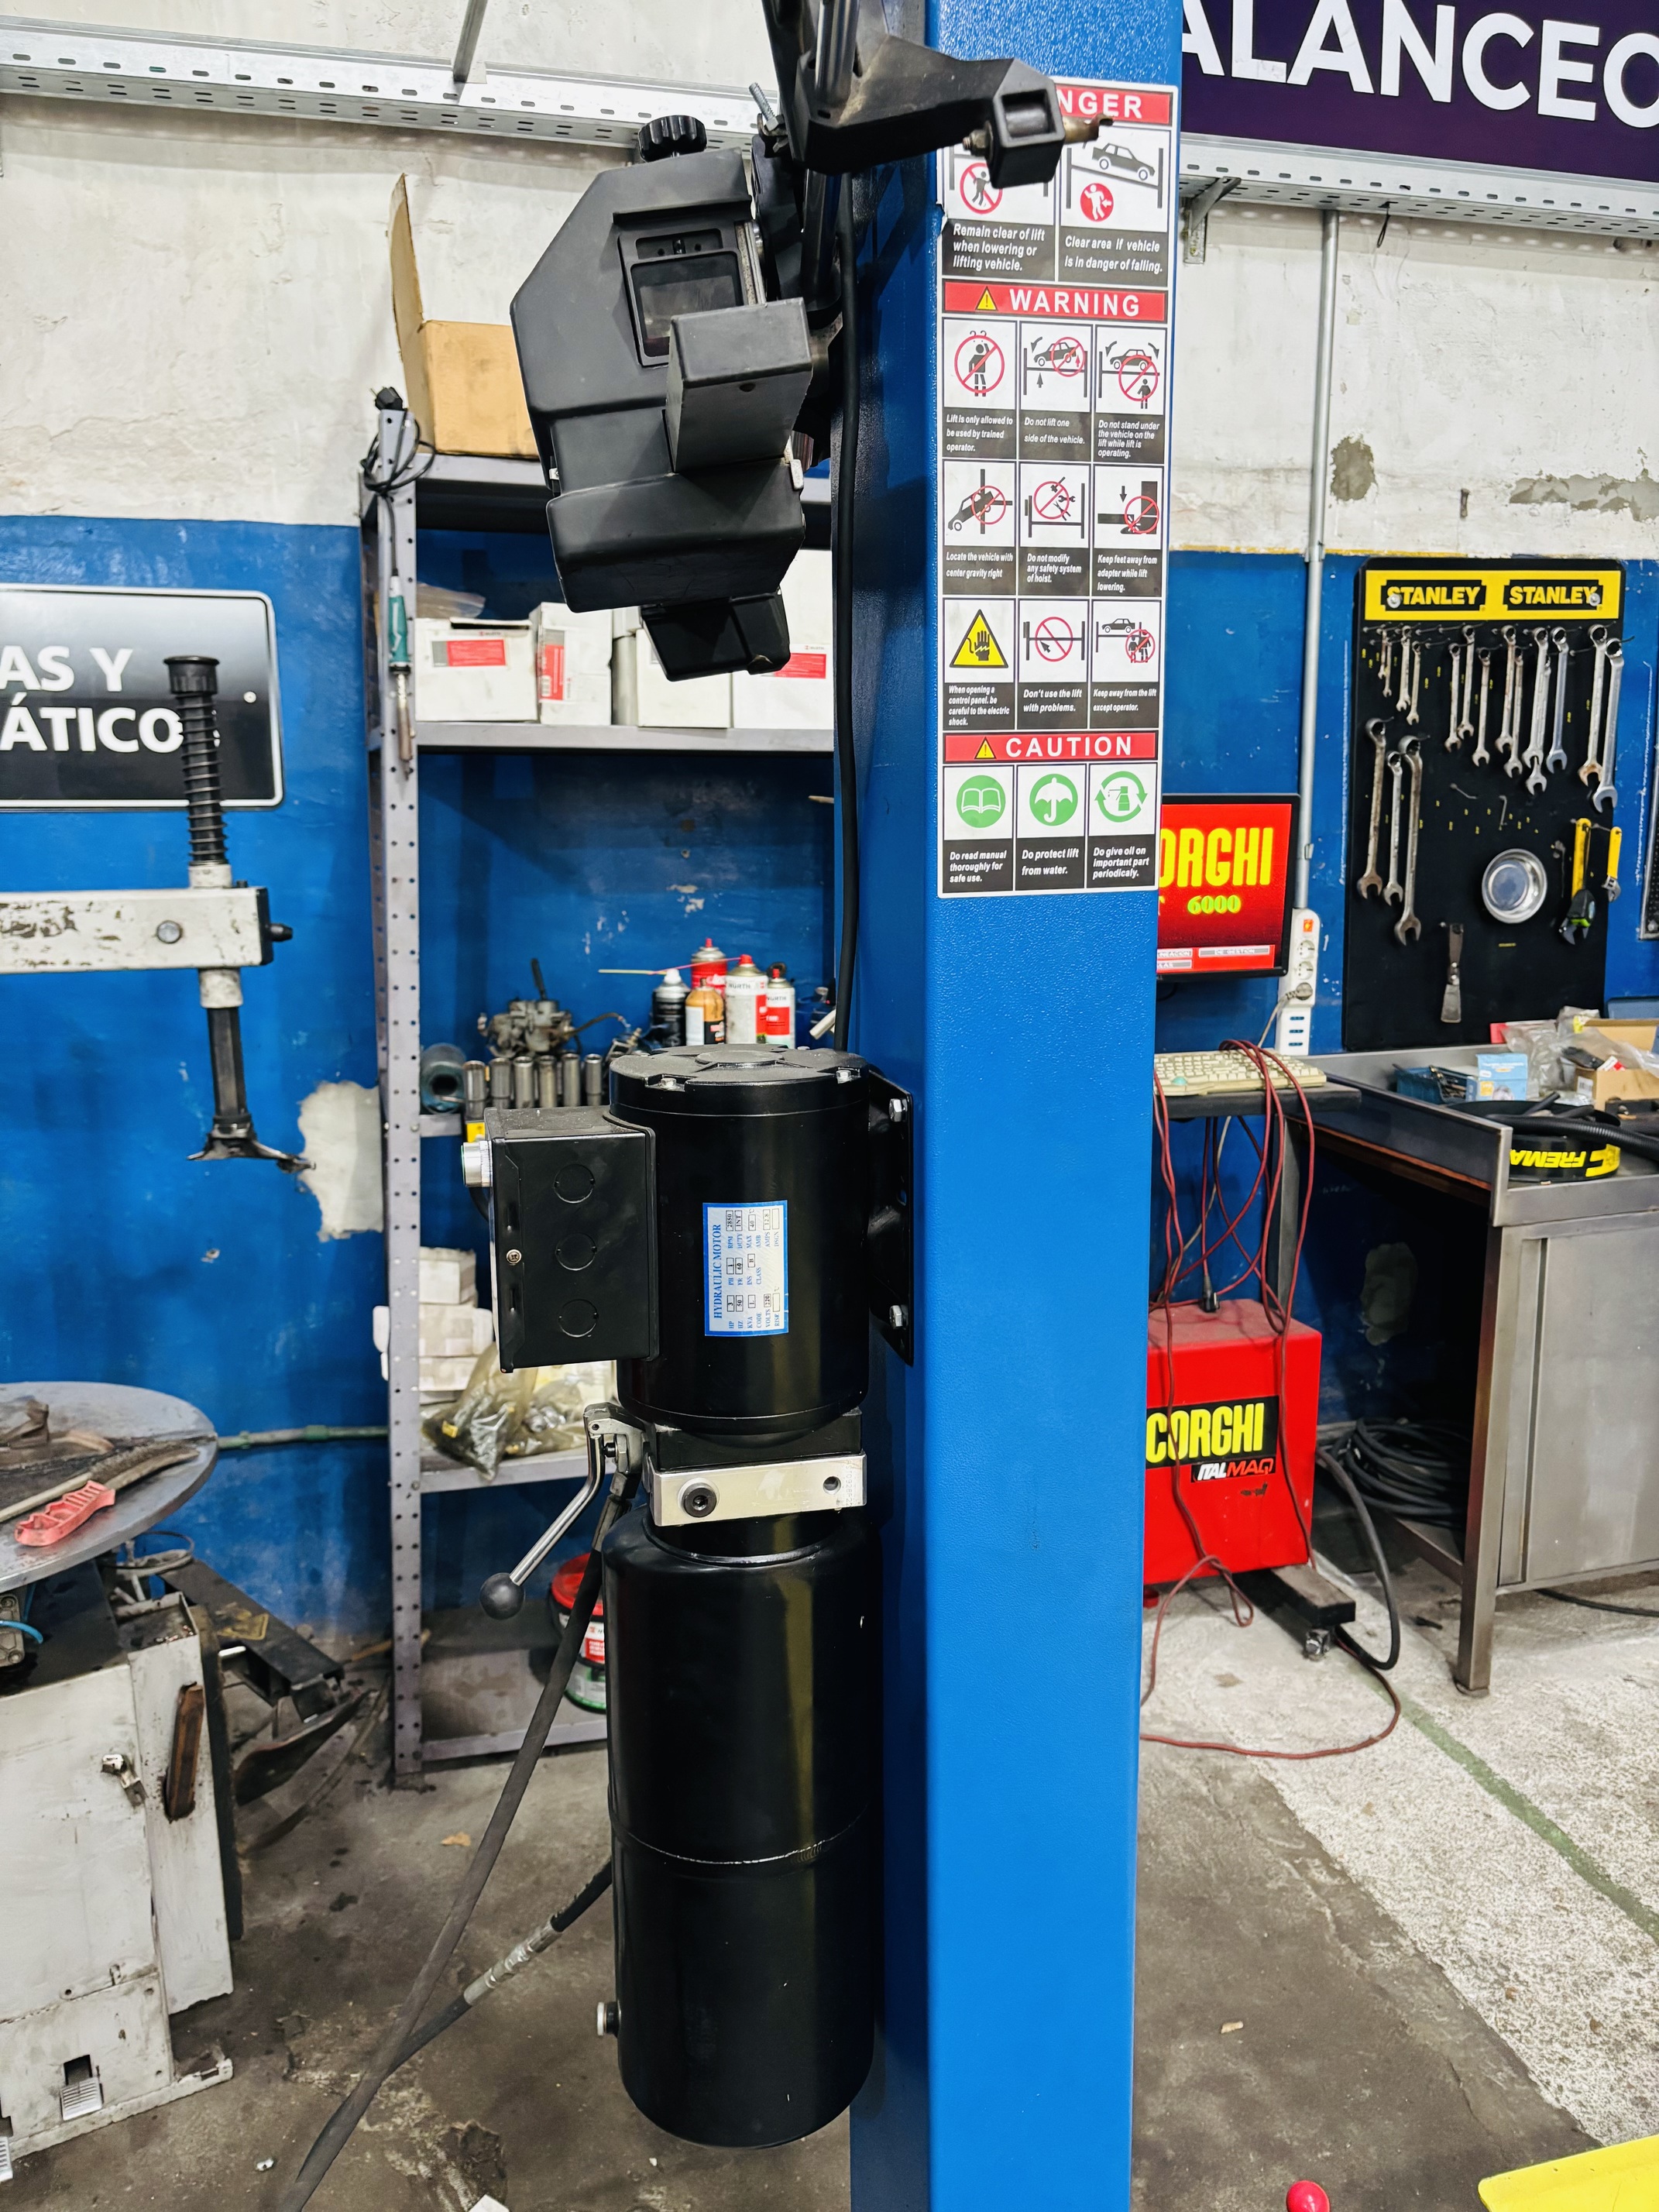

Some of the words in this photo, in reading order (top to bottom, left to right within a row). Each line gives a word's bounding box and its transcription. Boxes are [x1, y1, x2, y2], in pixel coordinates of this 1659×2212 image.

[953, 223, 991, 238] Remain
[993, 226, 1018, 239] clear
[1019, 228, 1030, 240] of
[1031, 228, 1045, 241] lift
[953, 239, 981, 252] when
[982, 241, 1024, 258] lowering
[1026, 247, 1037, 256] or
[1065, 235, 1090, 248] Clear
[1091, 239, 1111, 249] area
[1116, 239, 1124, 250] if
[1127, 239, 1159, 252] vehicle
[953, 256, 982, 271] lifting
[985, 258, 1022, 271] vehicle.
[1065, 256, 1073, 266] is
[1075, 256, 1084, 268] in
[1086, 257, 1119, 272] danger
[1120, 259, 1130, 270] of
[1131, 259, 1163, 274] falling.
[1009, 289, 1139, 316] WARNING
[959, 414, 964, 423] is
[966, 415, 980, 425] only
[981, 416, 1006, 424] allowed
[946, 428, 955, 437] be
[972, 429, 981, 439] by
[981, 430, 1004, 438] trained
[1048, 434, 1059, 443] the
[1060, 435, 1085, 444] vehicle.
[1098, 429, 1109, 438] the
[1110, 430, 1134, 438] vehicle
[946, 444, 975, 452] operator.
[1108, 439, 1125, 448] while
[1098, 448, 1131, 459] operating.
[946, 551, 967, 561] Locate
[967, 552, 977, 561] the
[978, 552, 1000, 562] vehicle
[1001, 553, 1013, 562] with
[1027, 553, 1036, 562] Do
[1037, 554, 1047, 562] not
[1048, 554, 1070, 565] modify
[1097, 555, 1113, 565] Keep
[1115, 555, 1126, 564] feet
[1127, 557, 1142, 566] away
[1143, 555, 1157, 564] from
[946, 568, 966, 577] center
[966, 568, 987, 579] gravity
[988, 568, 1003, 579] right
[1039, 564, 1059, 575] safety
[1060, 565, 1081, 575] system
[1097, 568, 1121, 579] adapter
[1121, 569, 1138, 578] while
[1139, 569, 1147, 578] lift
[1027, 574, 1034, 582] of
[1034, 574, 1052, 582] hoist.
[1097, 582, 1125, 593] lowering.
[1509, 586, 1599, 605] STANLEY
[89, 647, 133, 692] Y
[949, 685, 966, 694] When
[966, 685, 990, 695] opening
[1094, 689, 1108, 699] Keep
[949, 696, 970, 704] control
[949, 706, 970, 715] careful
[977, 706, 987, 715] the
[988, 706, 1010, 715] electric
[1024, 703, 1039, 712] with
[1039, 703, 1076, 713] problems.
[1094, 704, 1113, 713] except
[1113, 703, 1139, 713] operator.
[0, 692, 221, 754] ÁTICO
[949, 717, 968, 726] shock.
[1006, 736, 1132, 757] CAUTION
[961, 851, 979, 860] read
[979, 850, 1007, 859] manual
[1022, 850, 1034, 859] Do
[1035, 849, 1066, 861] protect
[1066, 848, 1079, 858] lift
[1094, 847, 1104, 856] Do
[1106, 847, 1123, 858] give
[1124, 847, 1135, 855] oil
[950, 862, 991, 873] thoroughly
[991, 861, 1003, 871] for
[1093, 858, 1132, 869] important
[1132, 857, 1149, 867] part
[1022, 866, 1042, 875] from
[1043, 865, 1068, 875] water.
[1092, 868, 1139, 880] periodicaly.
[950, 874, 966, 883] safe
[1187, 895, 1242, 915] 6000
[1510, 1149, 1586, 1168] FREMA
[713, 1224, 721, 1260] MOTOR
[713, 1262, 722, 1319] HYDRAULIC
[1146, 1403, 1265, 1463] CORGHI
[1197, 1458, 1274, 1481] ITALMAQ
